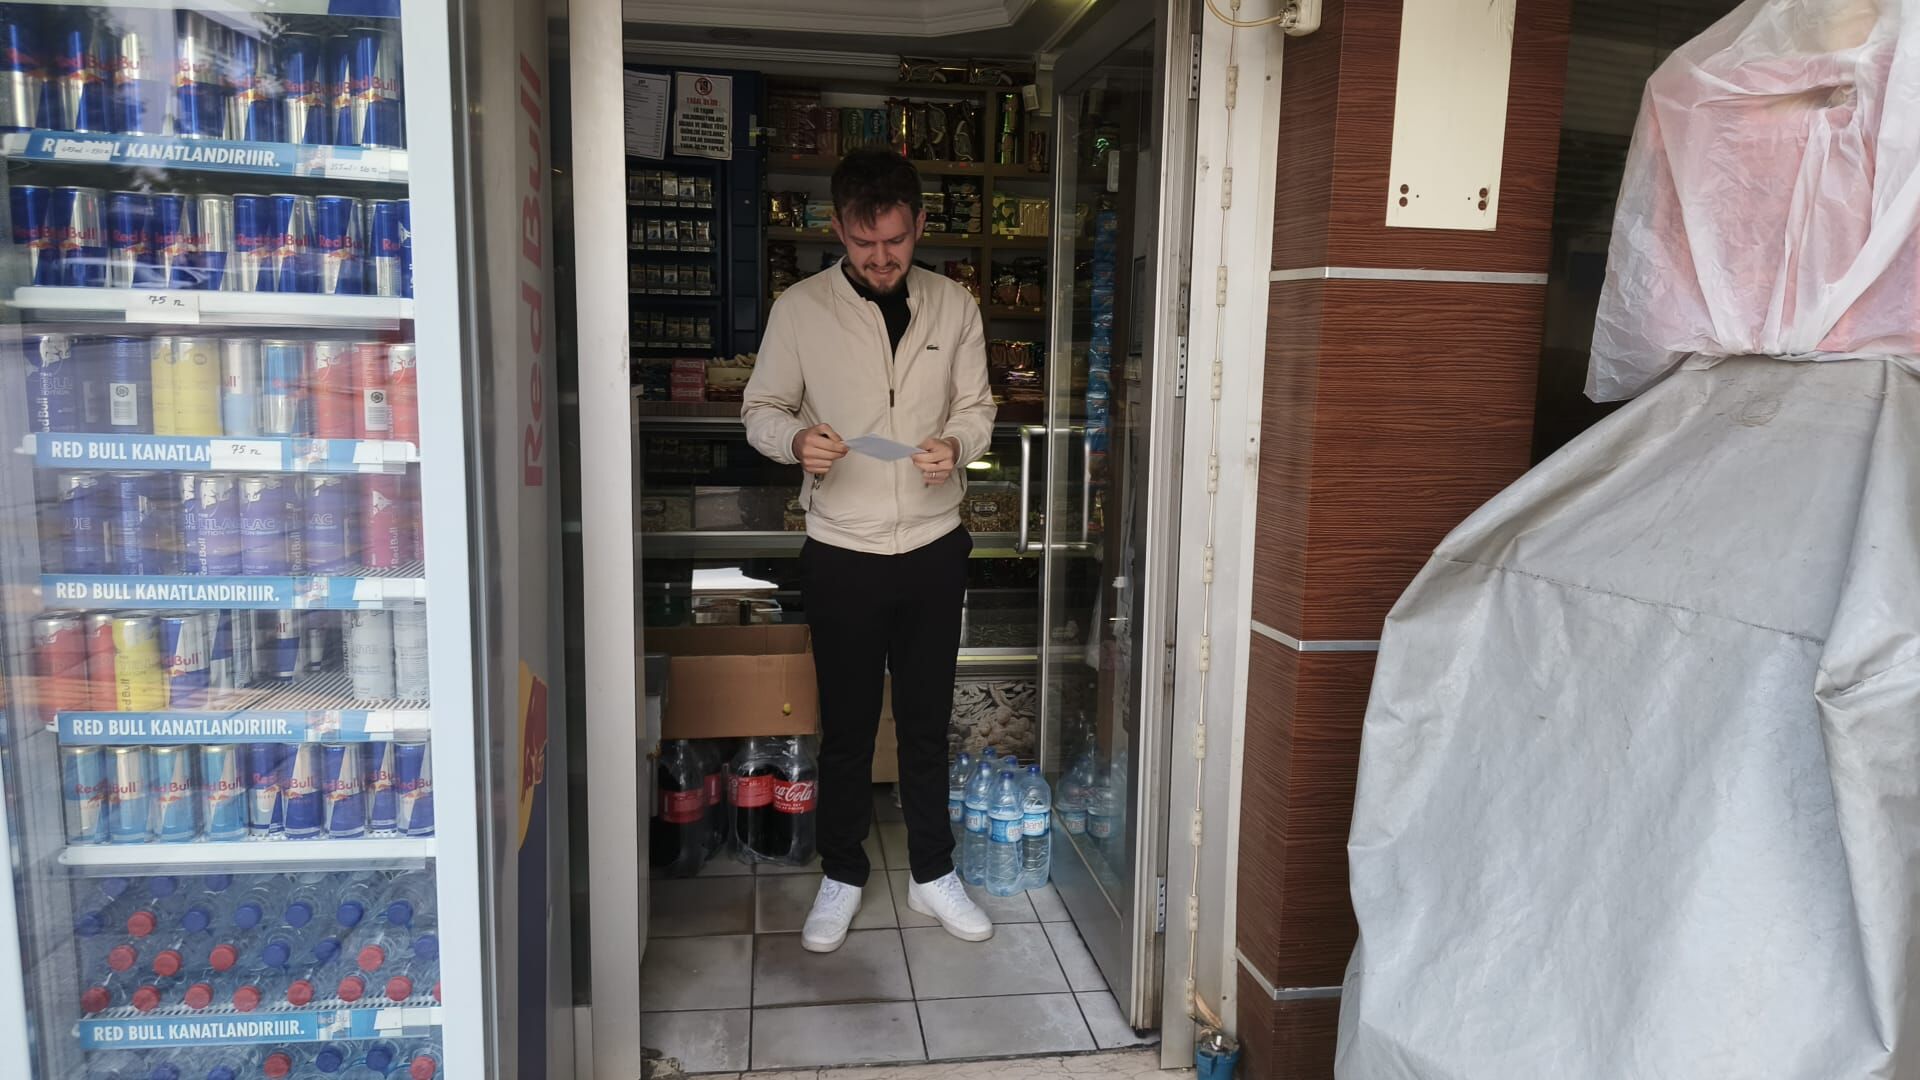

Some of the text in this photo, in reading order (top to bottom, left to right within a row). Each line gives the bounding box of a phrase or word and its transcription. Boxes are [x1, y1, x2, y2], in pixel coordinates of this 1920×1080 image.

[519, 50, 544, 487] Red Bull
[148, 295, 167, 305] 75
[51, 441, 83, 458] RED
[87, 442, 128, 460] BULL
[231, 444, 246, 455] 75
[55, 582, 88, 599] RED
[92, 583, 131, 600] BULL
[175, 653, 199, 666] Bull
[72, 719, 104, 735] RED
[108, 719, 146, 736] BULL
[291, 775, 314, 789] Bull
[93, 1026, 124, 1041] RED
[128, 1025, 165, 1041] BULL
